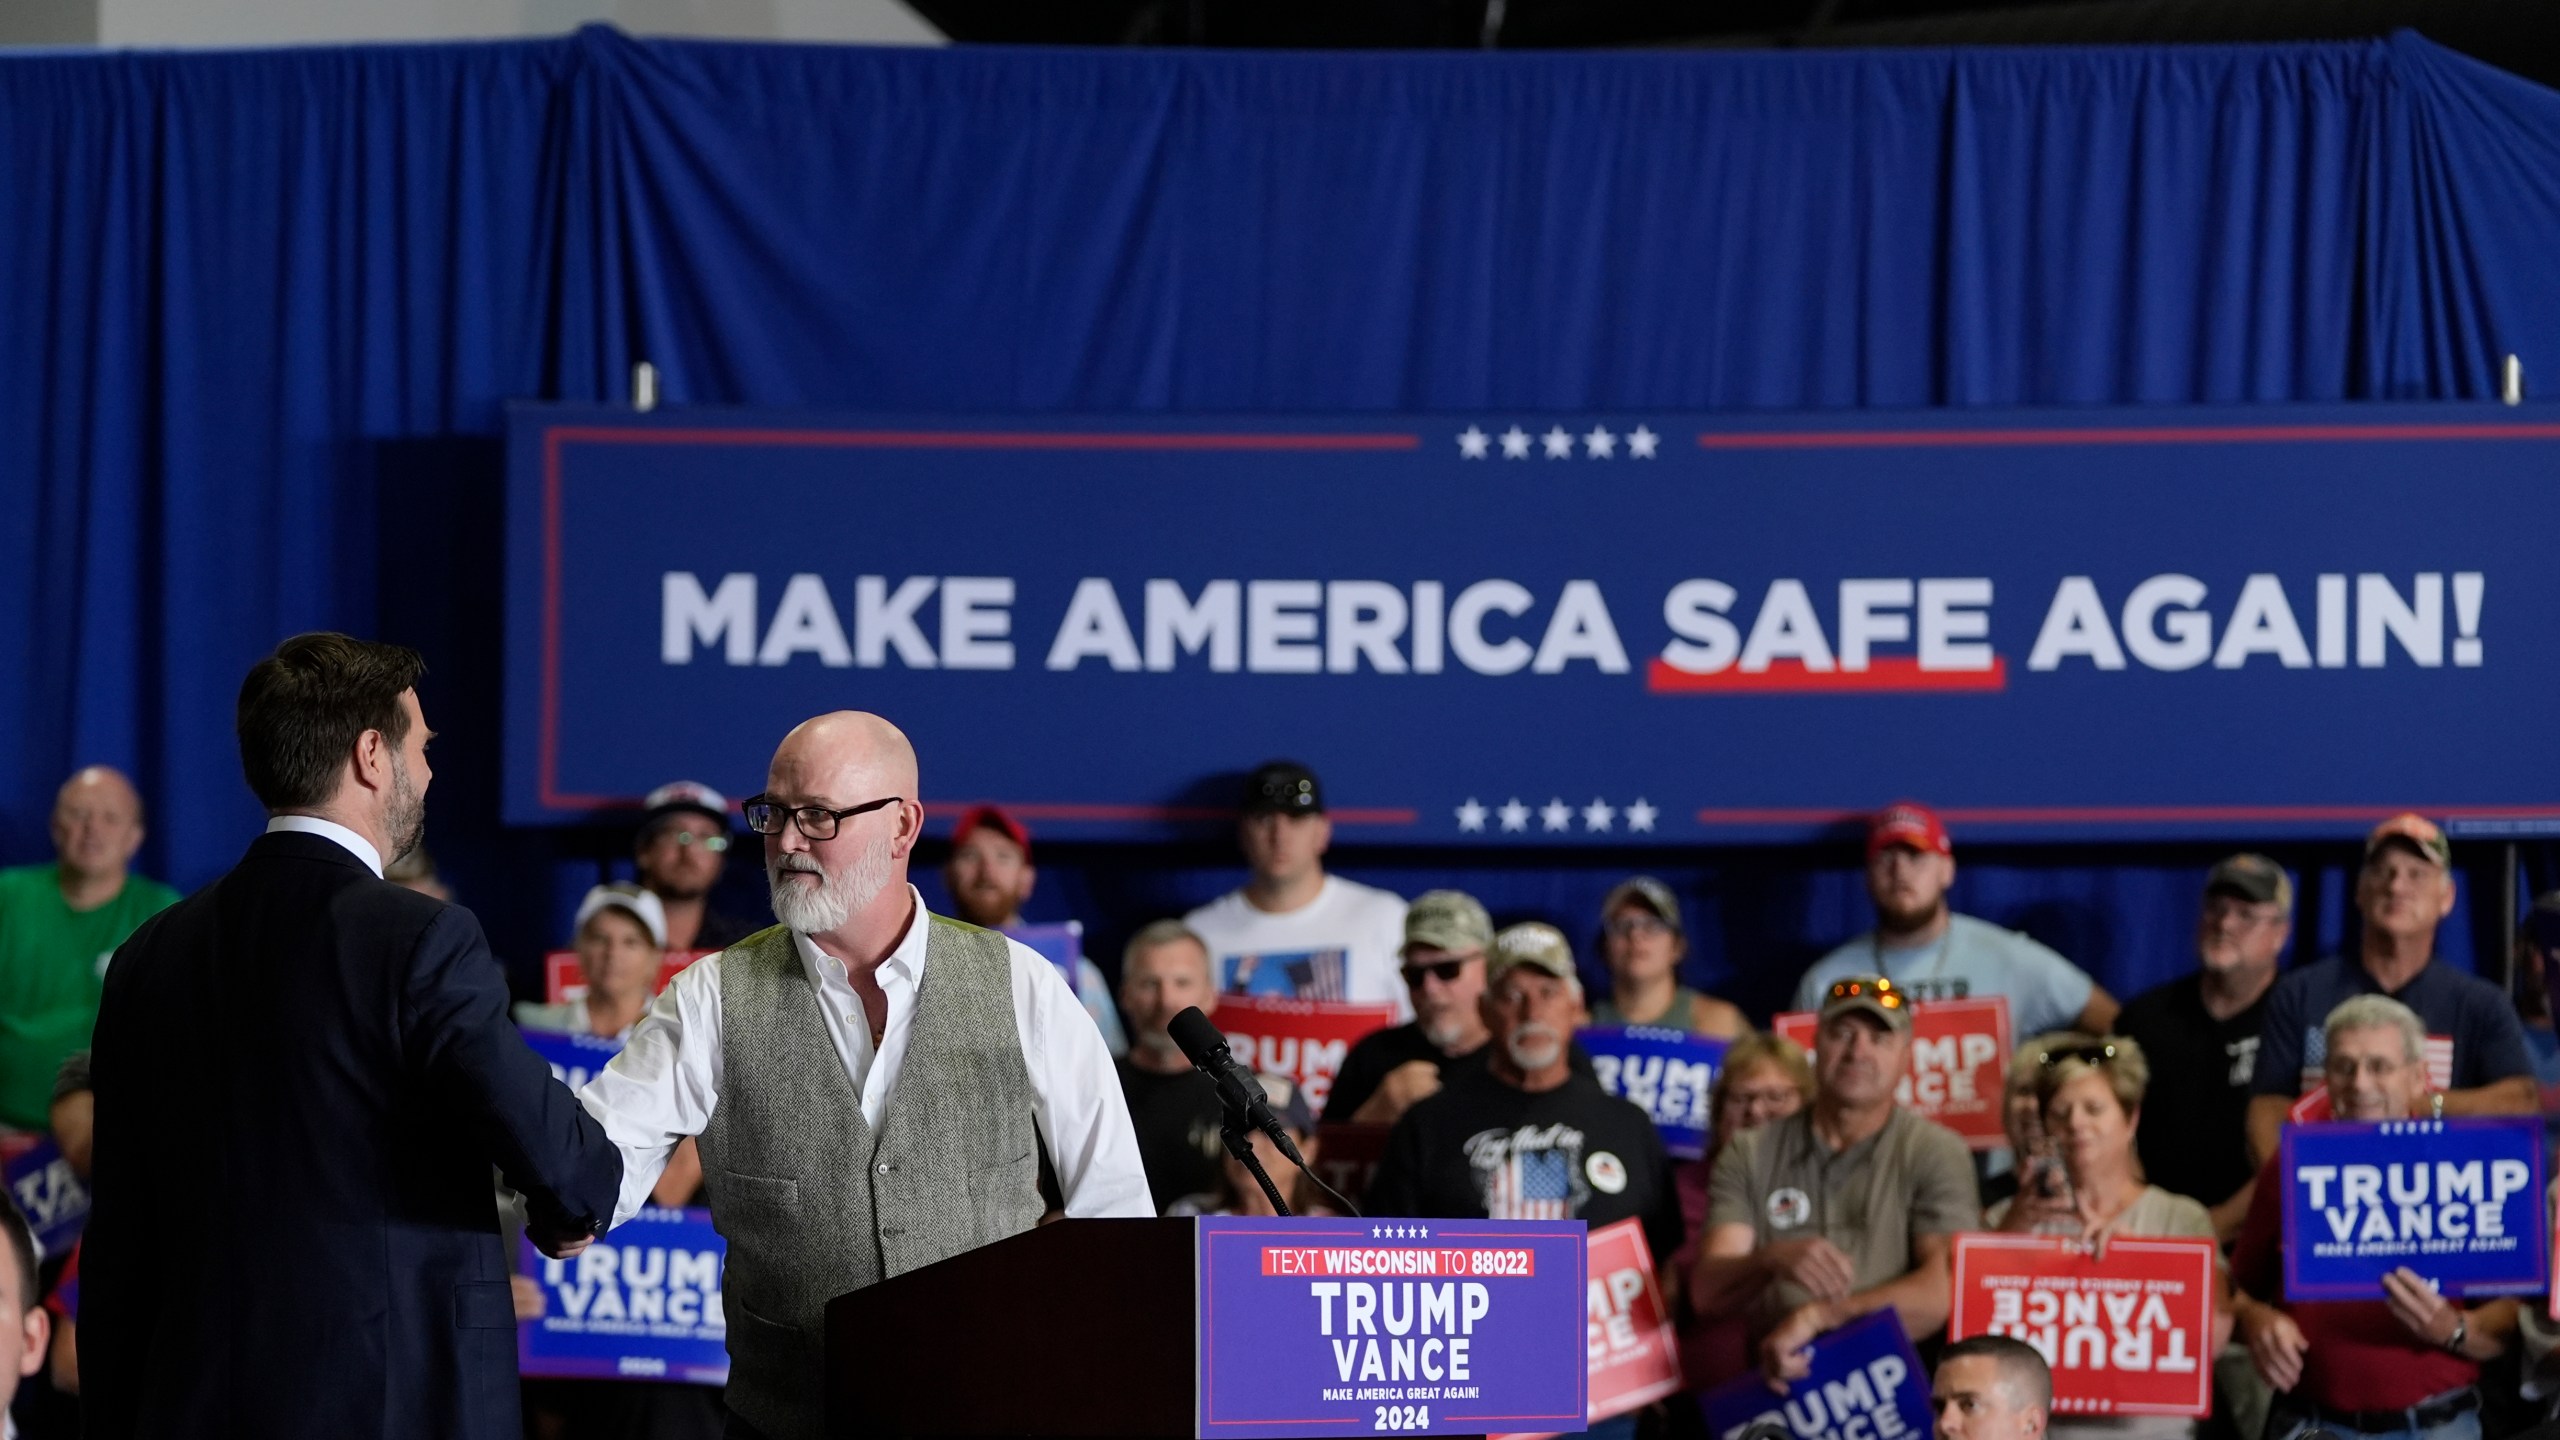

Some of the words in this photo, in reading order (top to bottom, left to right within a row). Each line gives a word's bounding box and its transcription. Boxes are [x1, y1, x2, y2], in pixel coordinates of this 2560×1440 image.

[661, 571, 1015, 669] MAKE
[1044, 577, 1631, 675] AMERICA
[1661, 577, 1993, 674] SAFE
[2027, 572, 2484, 671] AGAIN!
[1221, 1032, 1348, 1077] RUM
[1591, 1053, 1723, 1098] RUM
[2297, 1159, 2530, 1211] TRUMP
[2325, 1201, 2504, 1244] VANCE
[535, 1243, 725, 1293] TRUM
[1269, 1249, 1318, 1274] TEXT
[1324, 1250, 1436, 1275] WISCONSIN
[1441, 1251, 1466, 1274] TO
[1471, 1252, 1528, 1275] 88022
[2356, 1240, 2418, 1257] AMERICA
[1311, 1282, 1489, 1336] TRUMP
[1992, 1288, 2171, 1330] VANCE
[1332, 1338, 1470, 1382] VANCE
[1988, 1322, 2196, 1373] TRUM
[1323, 1388, 1353, 1400] MAKE
[1356, 1388, 1404, 1400] AMERICA
[1407, 1387, 1440, 1400] GREAT
[1443, 1386, 1479, 1399] AGAIN!
[1375, 1406, 1429, 1431] 2024
